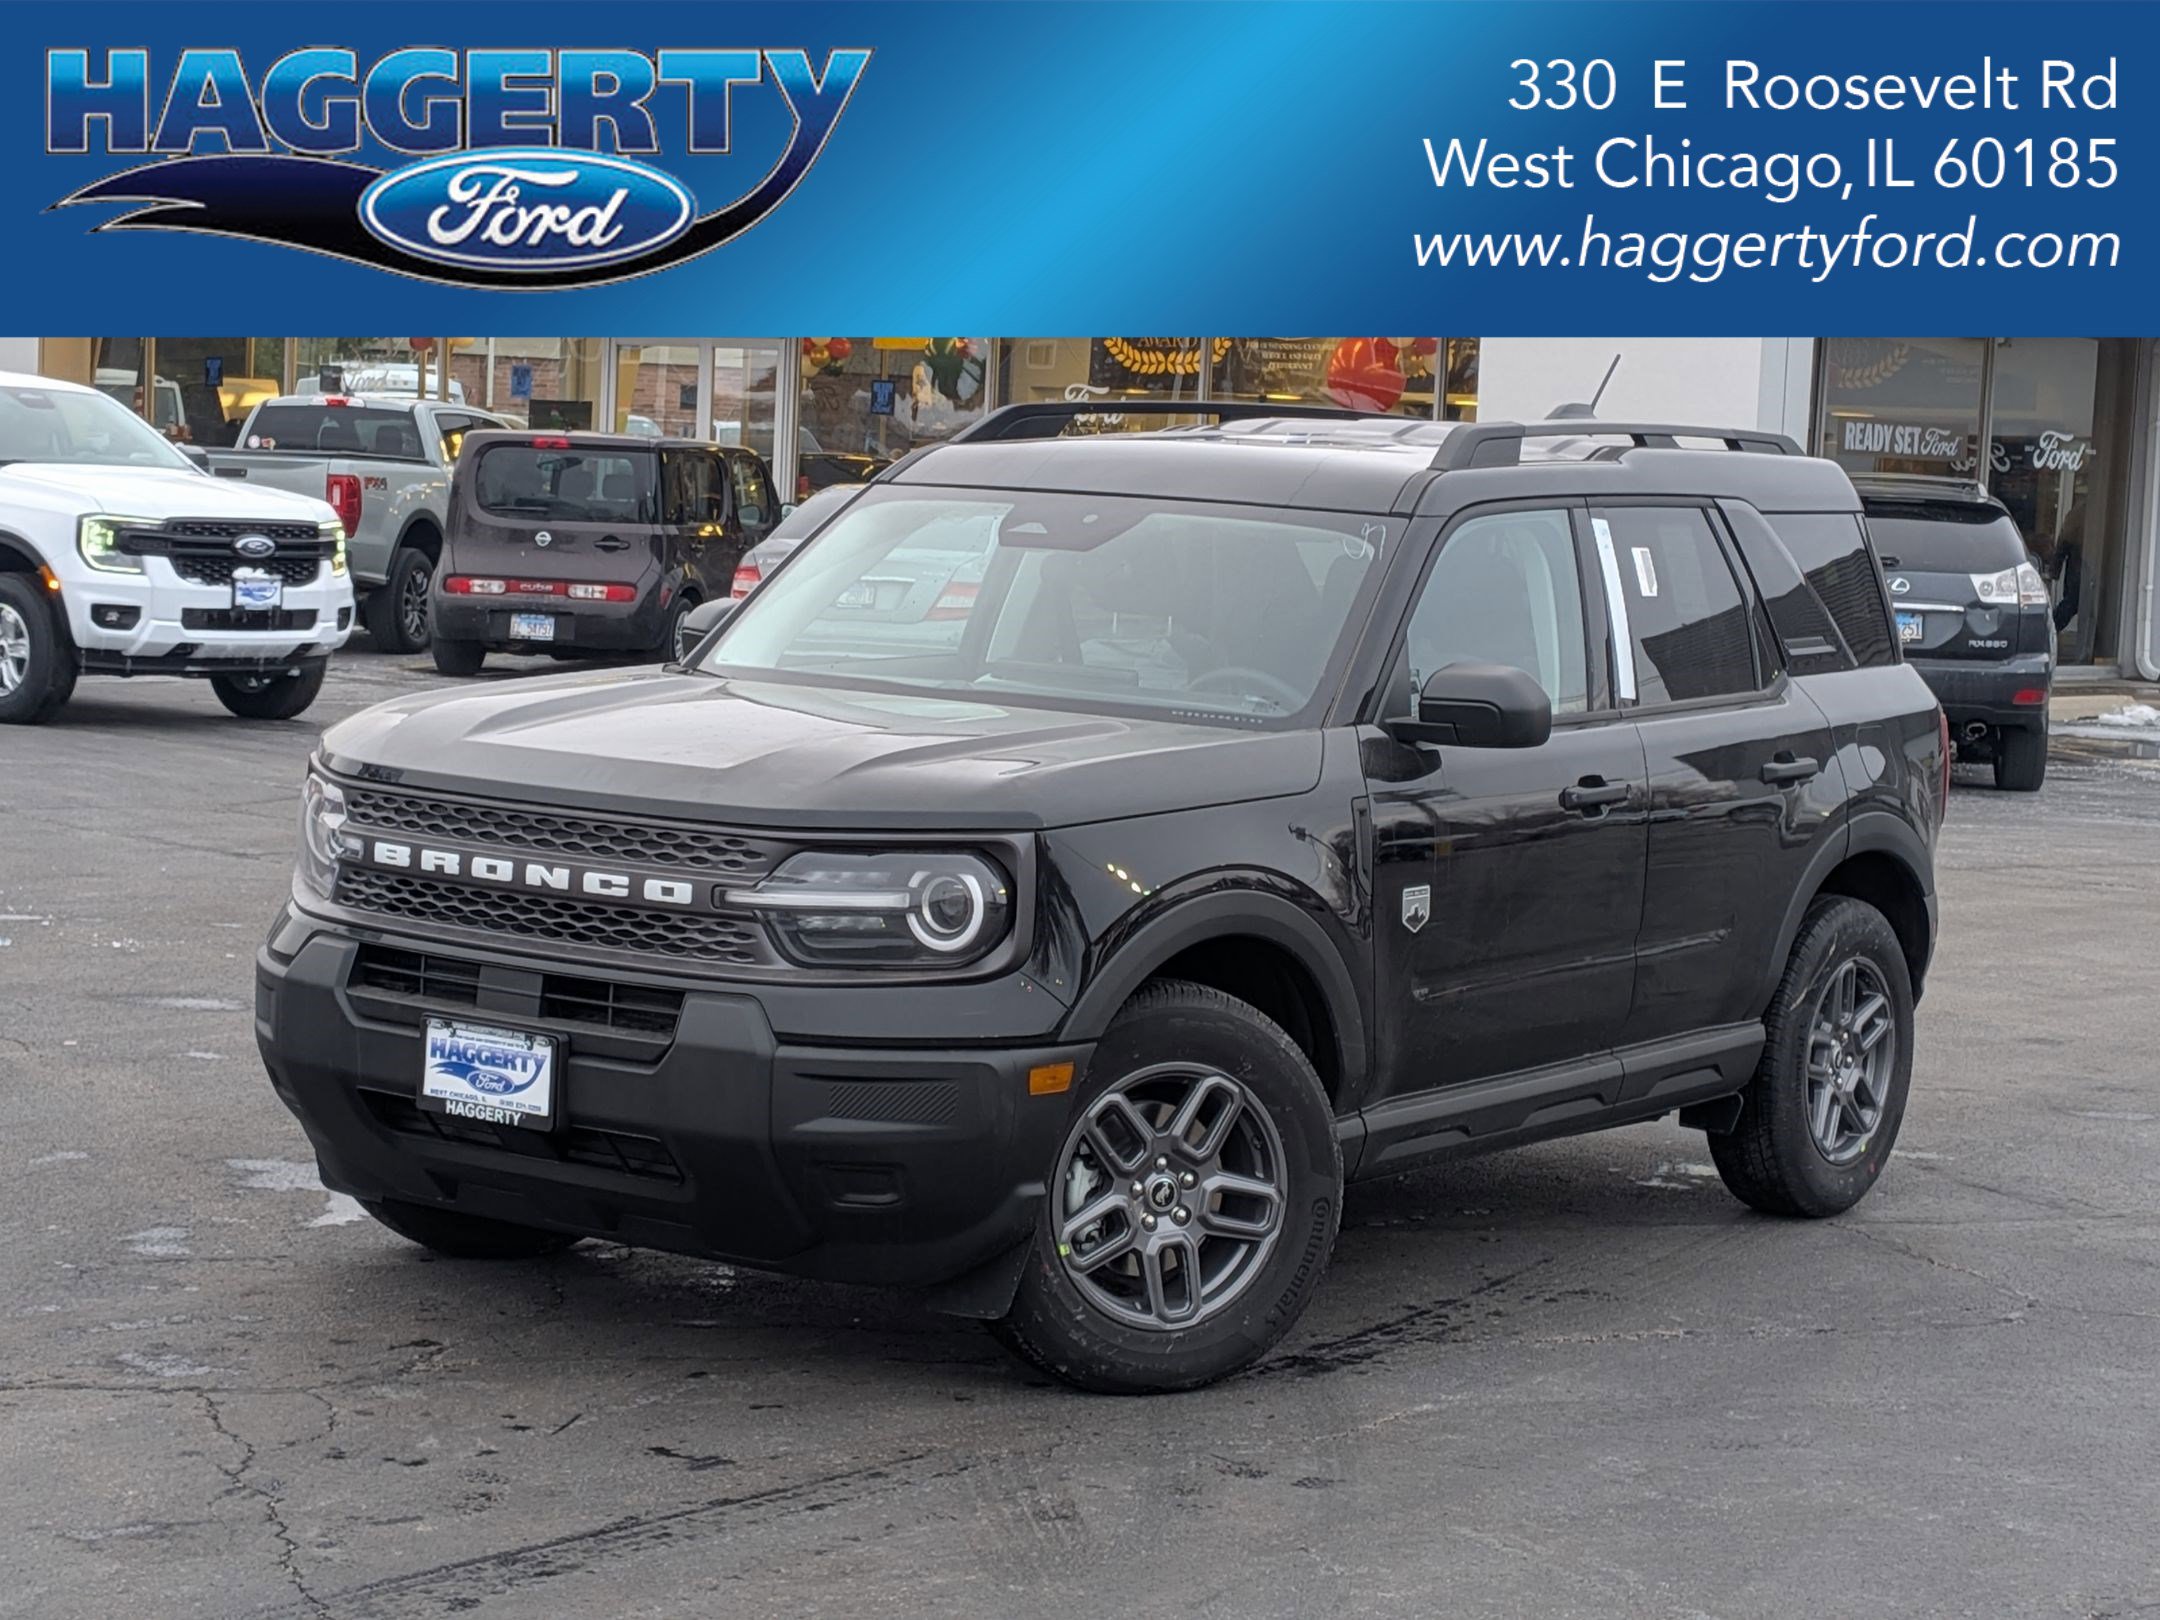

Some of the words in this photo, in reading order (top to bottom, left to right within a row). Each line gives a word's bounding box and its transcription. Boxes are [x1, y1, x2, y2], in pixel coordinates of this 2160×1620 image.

[1844, 421, 1893, 453] READY
[1894, 424, 1922, 455] SET
[1920, 427, 1959, 457] Ford
[2032, 429, 2086, 472] Ford
[364, 476, 388, 491] FX4
[519, 582, 554, 592] cube
[373, 841, 694, 905] BRONCO
[429, 1036, 548, 1073] HAGGERTY
[475, 1071, 506, 1093] Ford
[446, 1100, 521, 1126] HAGGERTY
